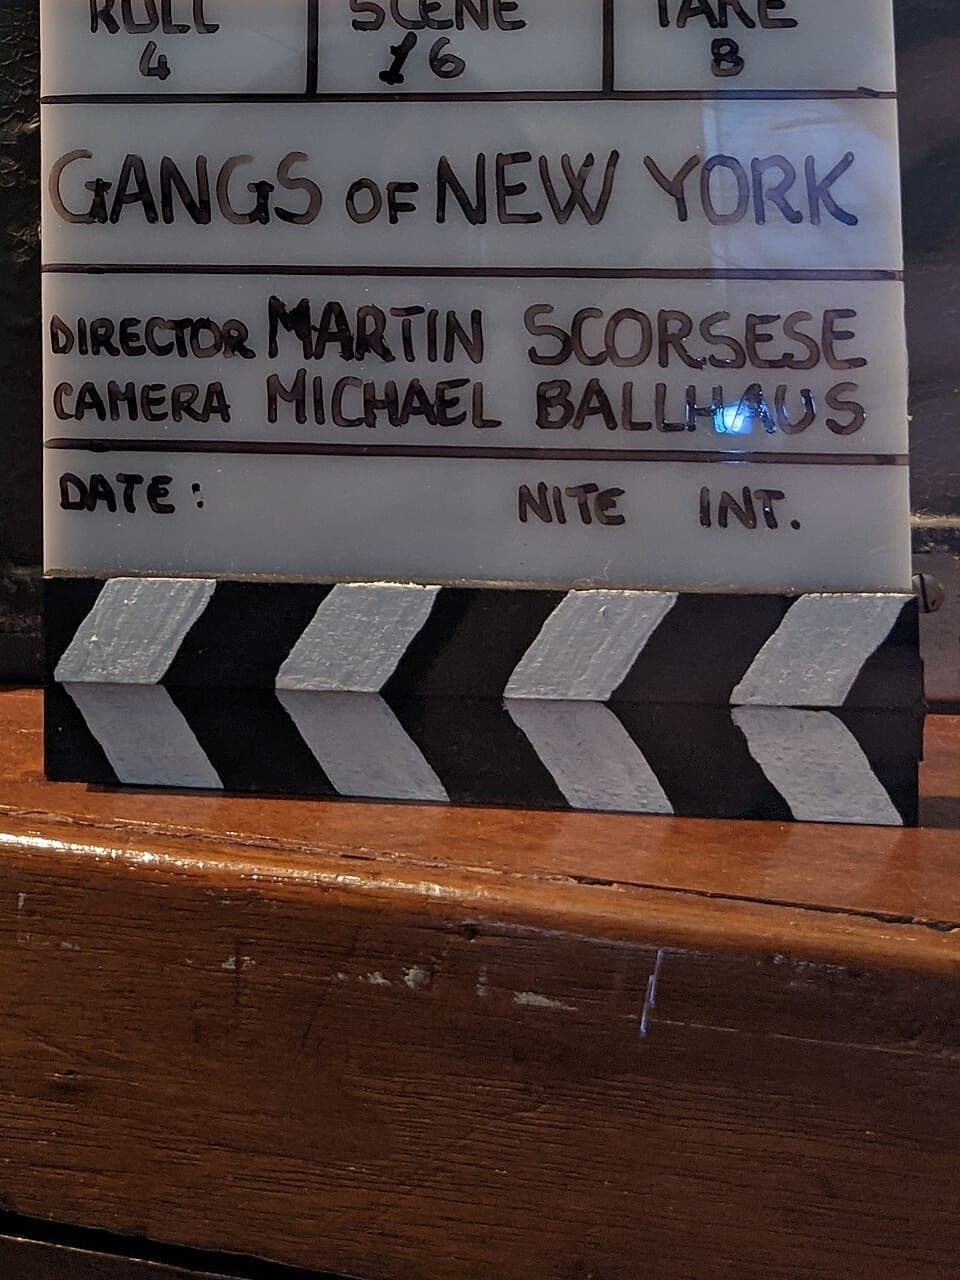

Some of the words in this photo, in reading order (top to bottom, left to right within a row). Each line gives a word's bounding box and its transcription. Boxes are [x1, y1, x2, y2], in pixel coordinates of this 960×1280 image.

[139, 41, 171, 80] 4
[379, 31, 465, 85] 16
[711, 38, 744, 77] 8
[49, 149, 322, 225] GANGS
[346, 178, 419, 224] OF
[437, 149, 620, 226] NEW
[643, 151, 859, 226] YORK
[52, 316, 256, 359] DIRECTOR
[268, 296, 484, 364] MARTIN
[524, 304, 867, 370] SCORSESE
[54, 381, 231, 423] CAMERA
[266, 368, 502, 429] MICHAEL
[535, 378, 868, 435] BALLHAUS
[518, 482, 626, 526] NITE
[699, 486, 801, 530] INT.
